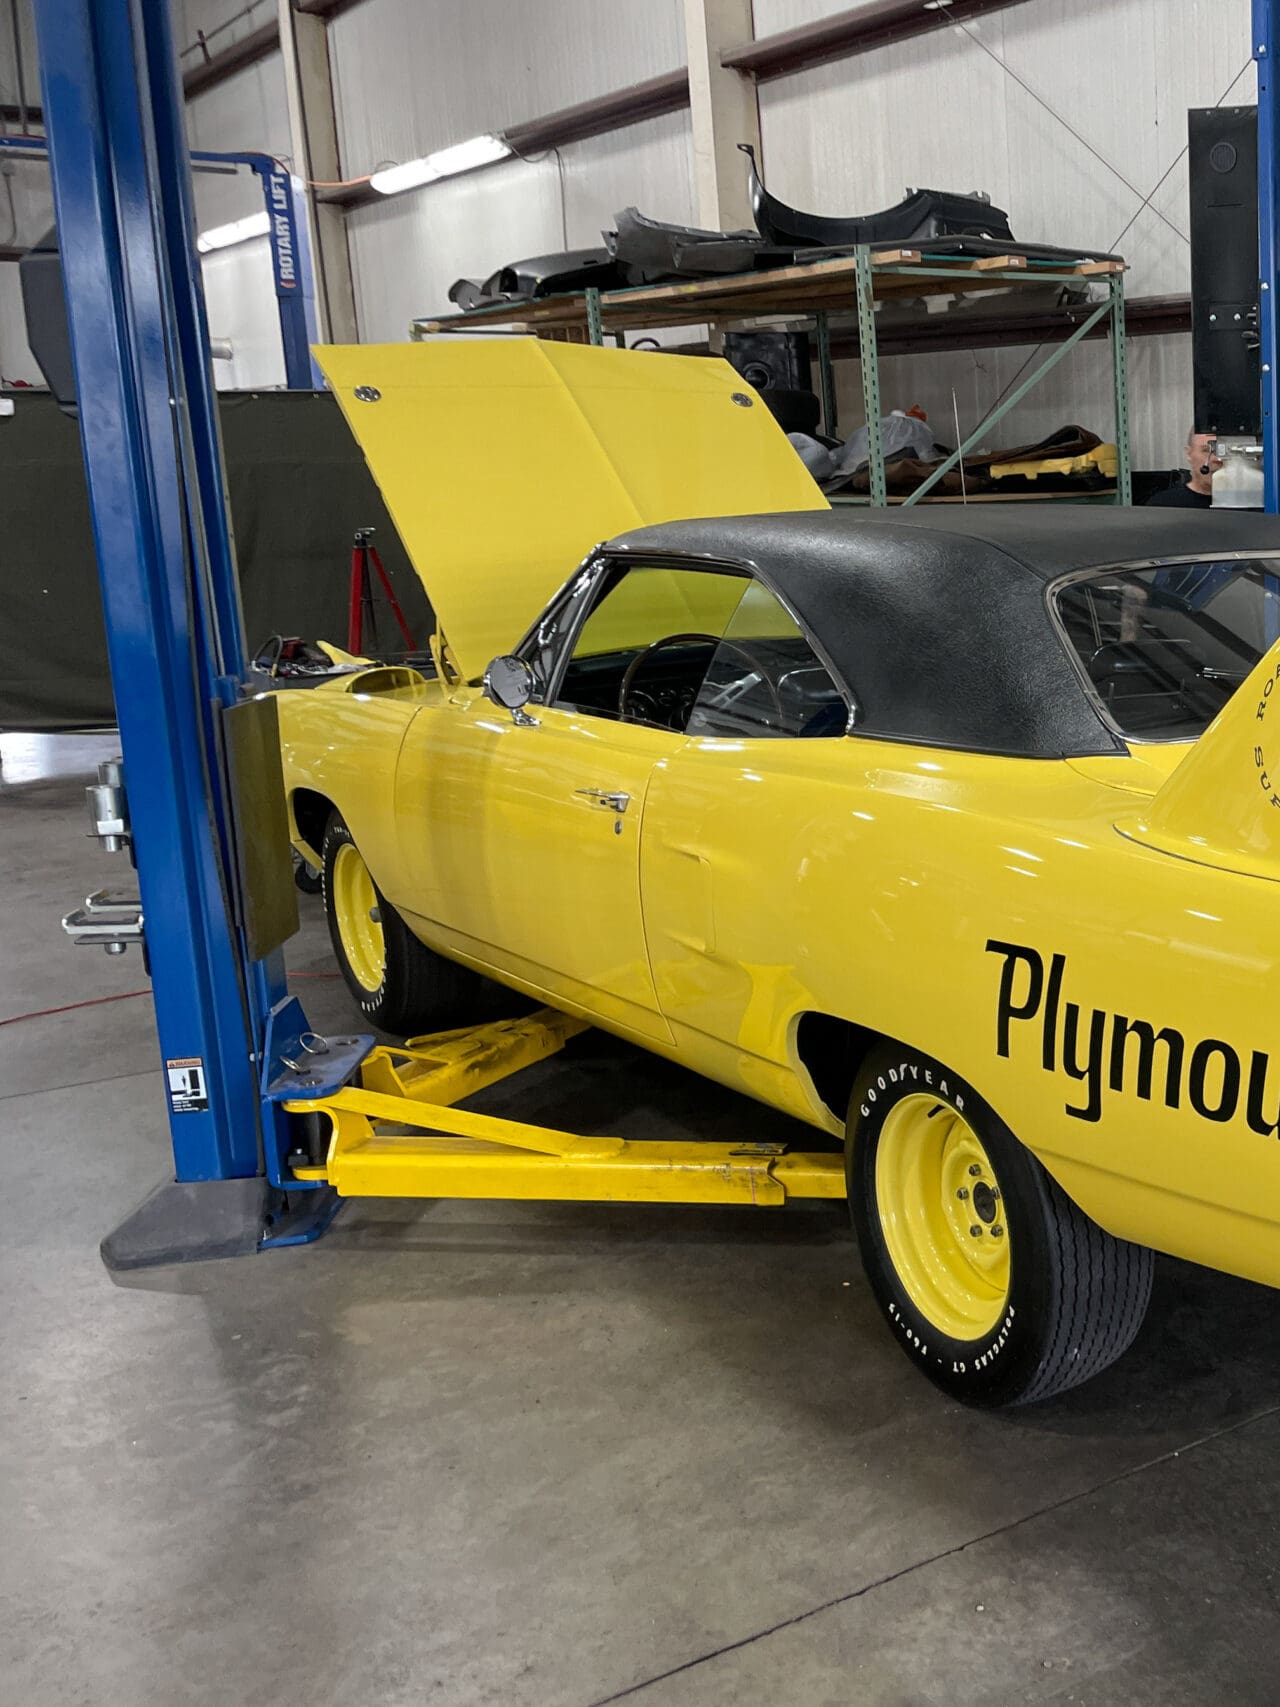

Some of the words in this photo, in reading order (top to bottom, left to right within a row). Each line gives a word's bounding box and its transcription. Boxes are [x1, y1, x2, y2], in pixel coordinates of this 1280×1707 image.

[270, 174, 288, 209] LIFT
[274, 214, 295, 280] ROTARY
[860, 1063, 964, 1117] GOODYEAR
[974, 1304, 1015, 1371] POLYGLAS
[952, 1360, 967, 1374] GT
